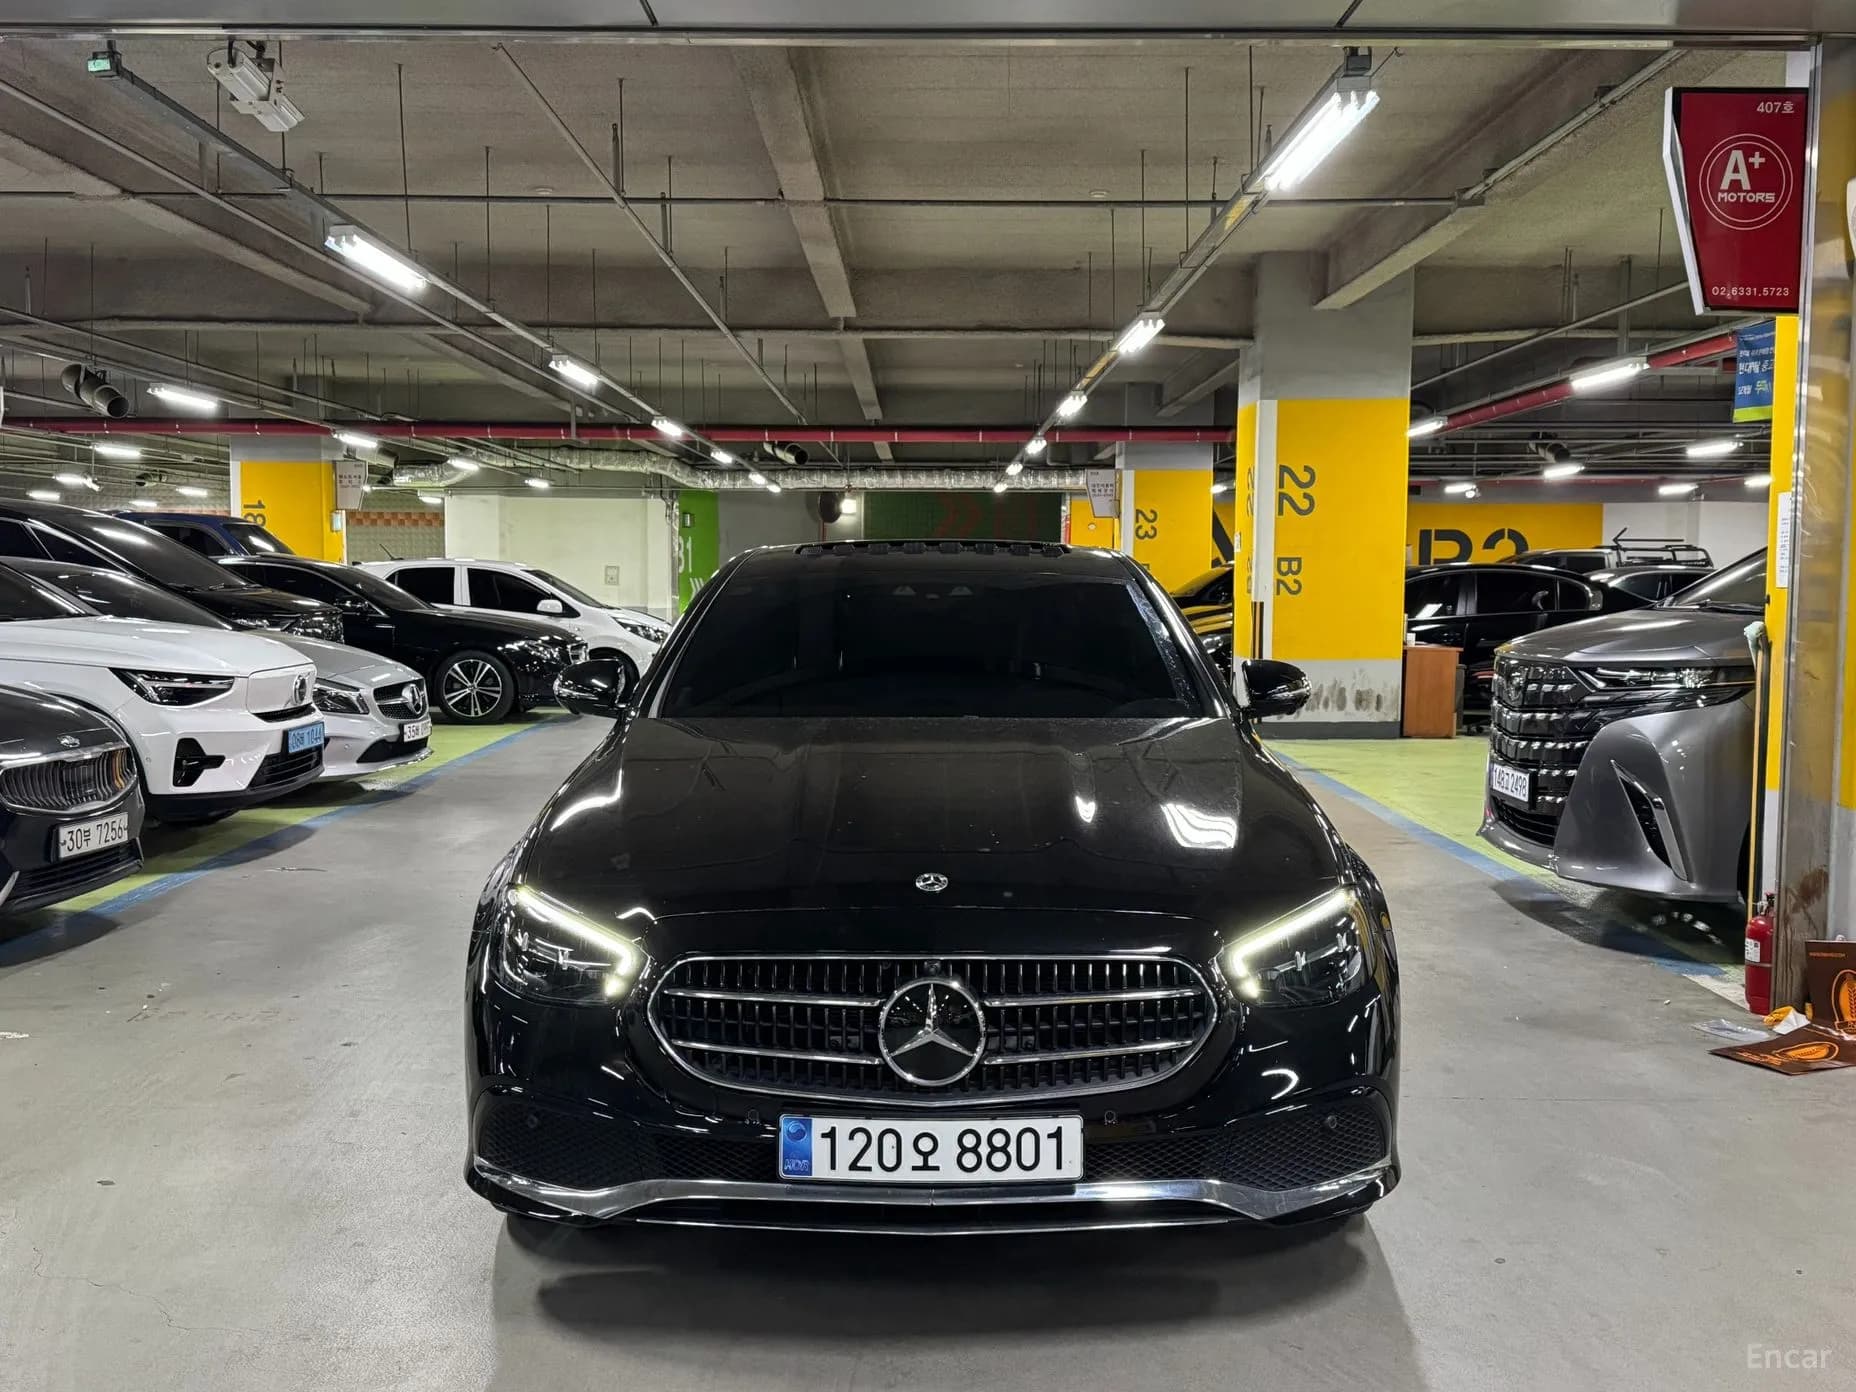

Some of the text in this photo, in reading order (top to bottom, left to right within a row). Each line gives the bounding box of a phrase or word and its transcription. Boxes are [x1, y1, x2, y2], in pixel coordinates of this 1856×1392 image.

[1757, 101, 1794, 113] 407호
[1720, 150, 1765, 190] A+
[1718, 192, 1775, 203] MOTORS
[1135, 508, 1158, 540] 23
[1275, 464, 1316, 596] 22 B2
[66, 818, 123, 851] 30부 7256
[820, 1126, 1063, 1173] 120오 8801
